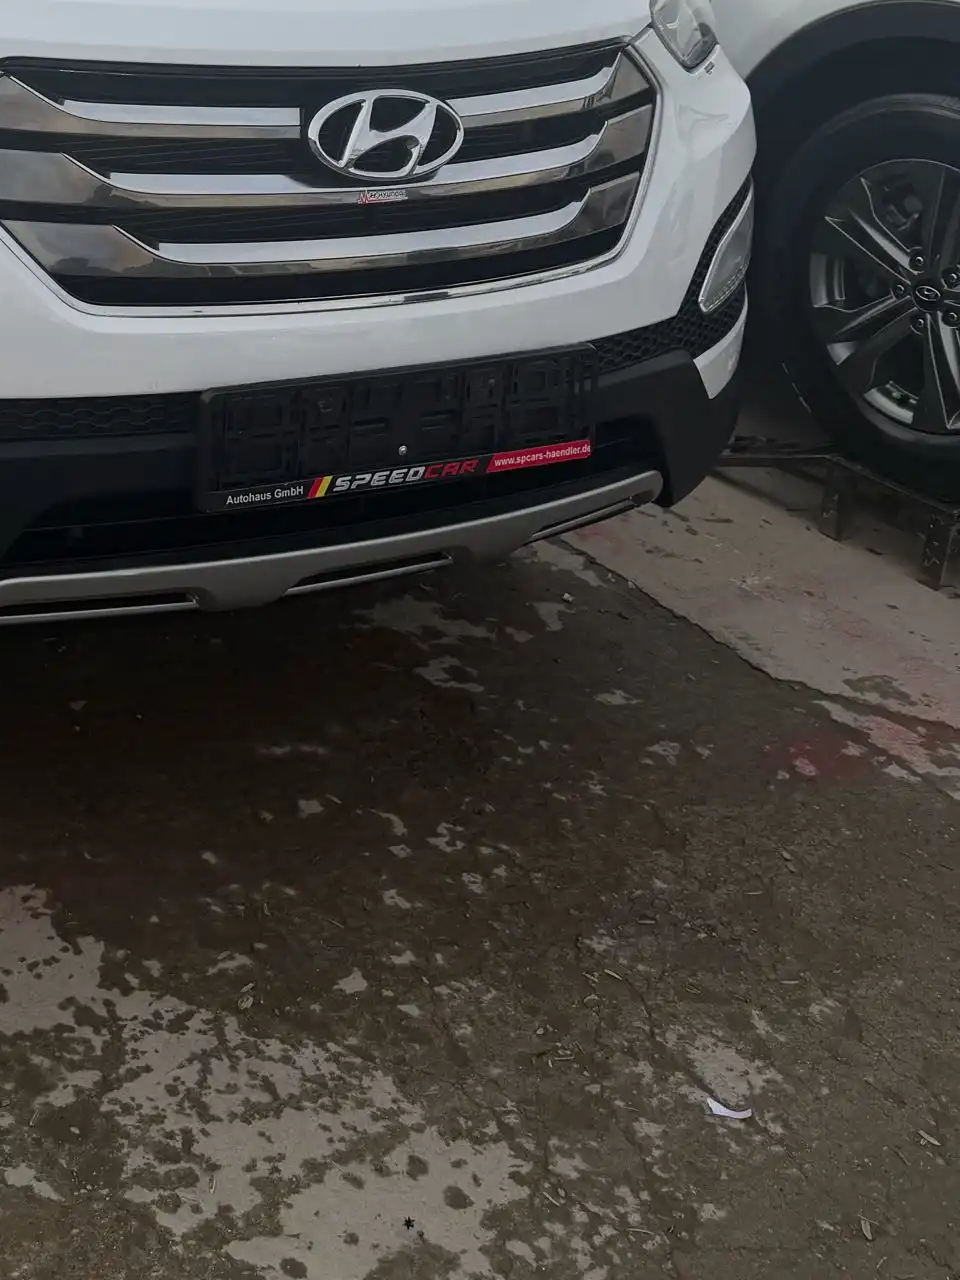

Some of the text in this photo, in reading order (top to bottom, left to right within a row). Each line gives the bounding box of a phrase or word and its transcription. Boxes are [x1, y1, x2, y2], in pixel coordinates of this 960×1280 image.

[494, 443, 591, 466] www.spcars-haendler.de
[333, 459, 479, 492] SPEEDCAR
[226, 485, 304, 505] Autohaus GmbH
